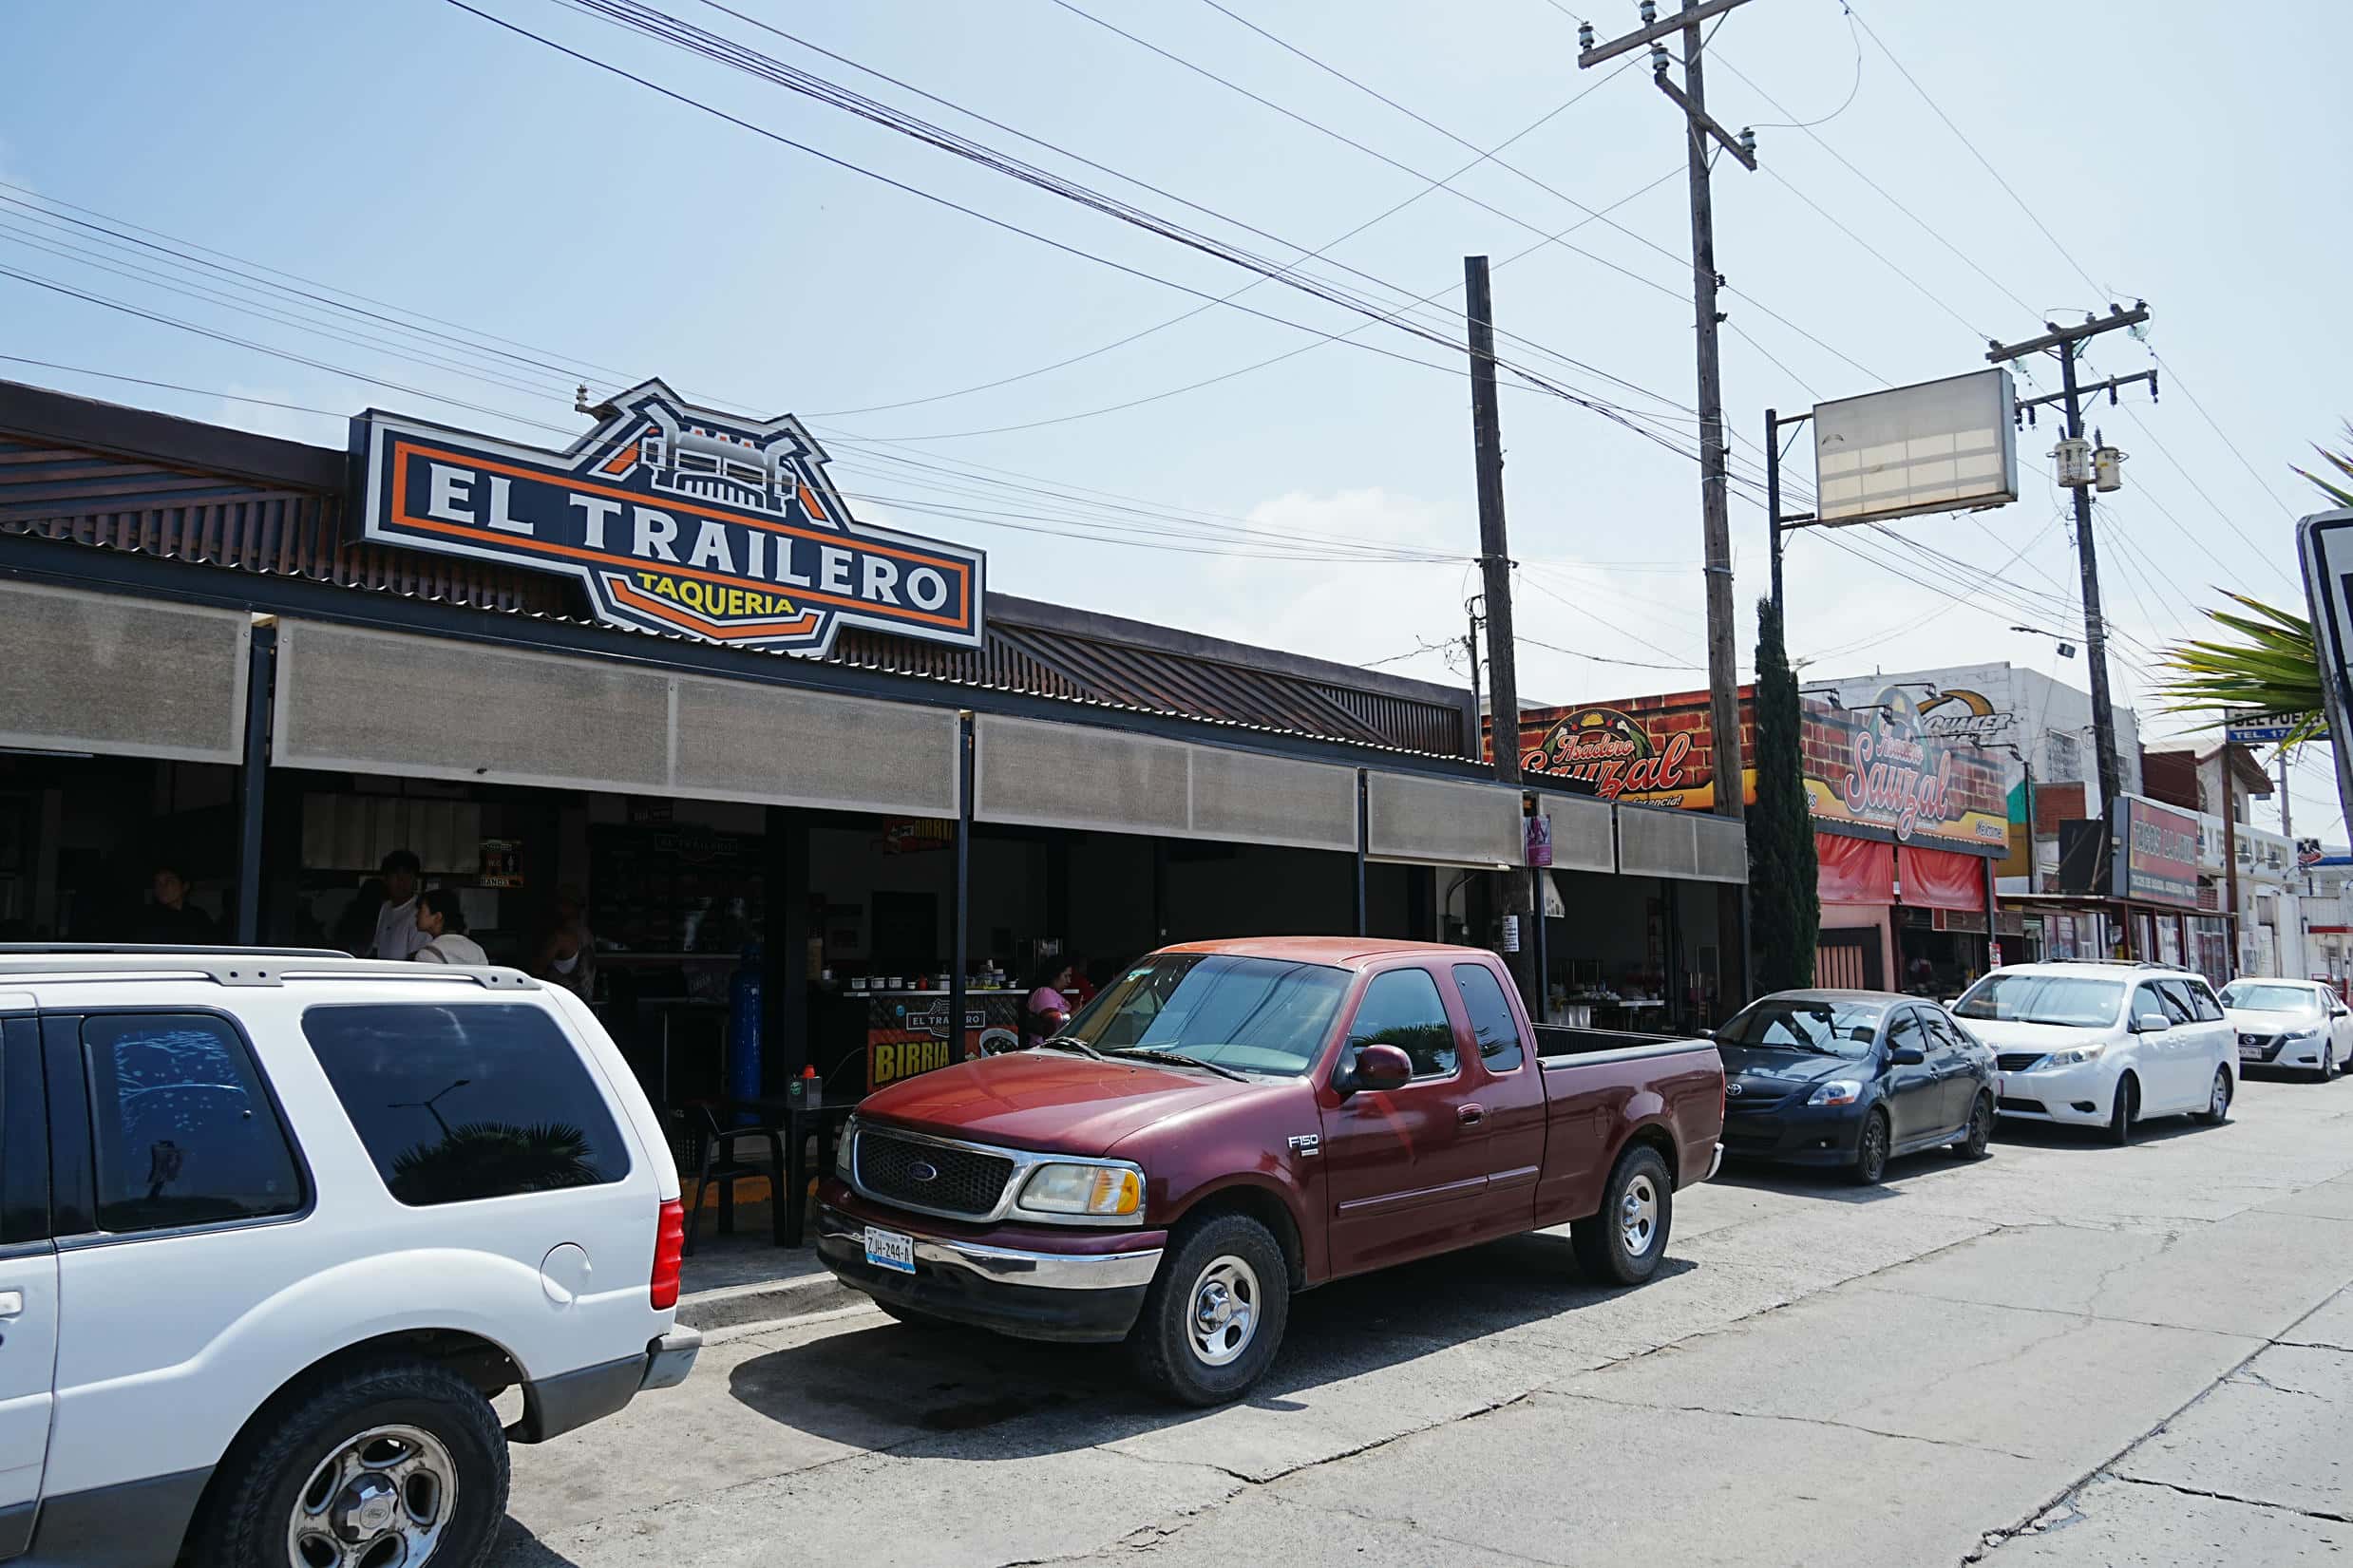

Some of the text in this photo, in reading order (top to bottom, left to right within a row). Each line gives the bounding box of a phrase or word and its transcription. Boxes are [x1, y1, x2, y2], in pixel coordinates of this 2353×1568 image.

[427, 463, 949, 613] EL TRAILERO
[636, 572, 796, 616] TAQUERIA
[1553, 733, 1635, 763] Asadero
[2233, 730, 2266, 739] TEL.
[1844, 731, 1951, 841] Sauzal
[912, 1015, 980, 1026] EL TRARO
[874, 1040, 950, 1084] BIRRIA
